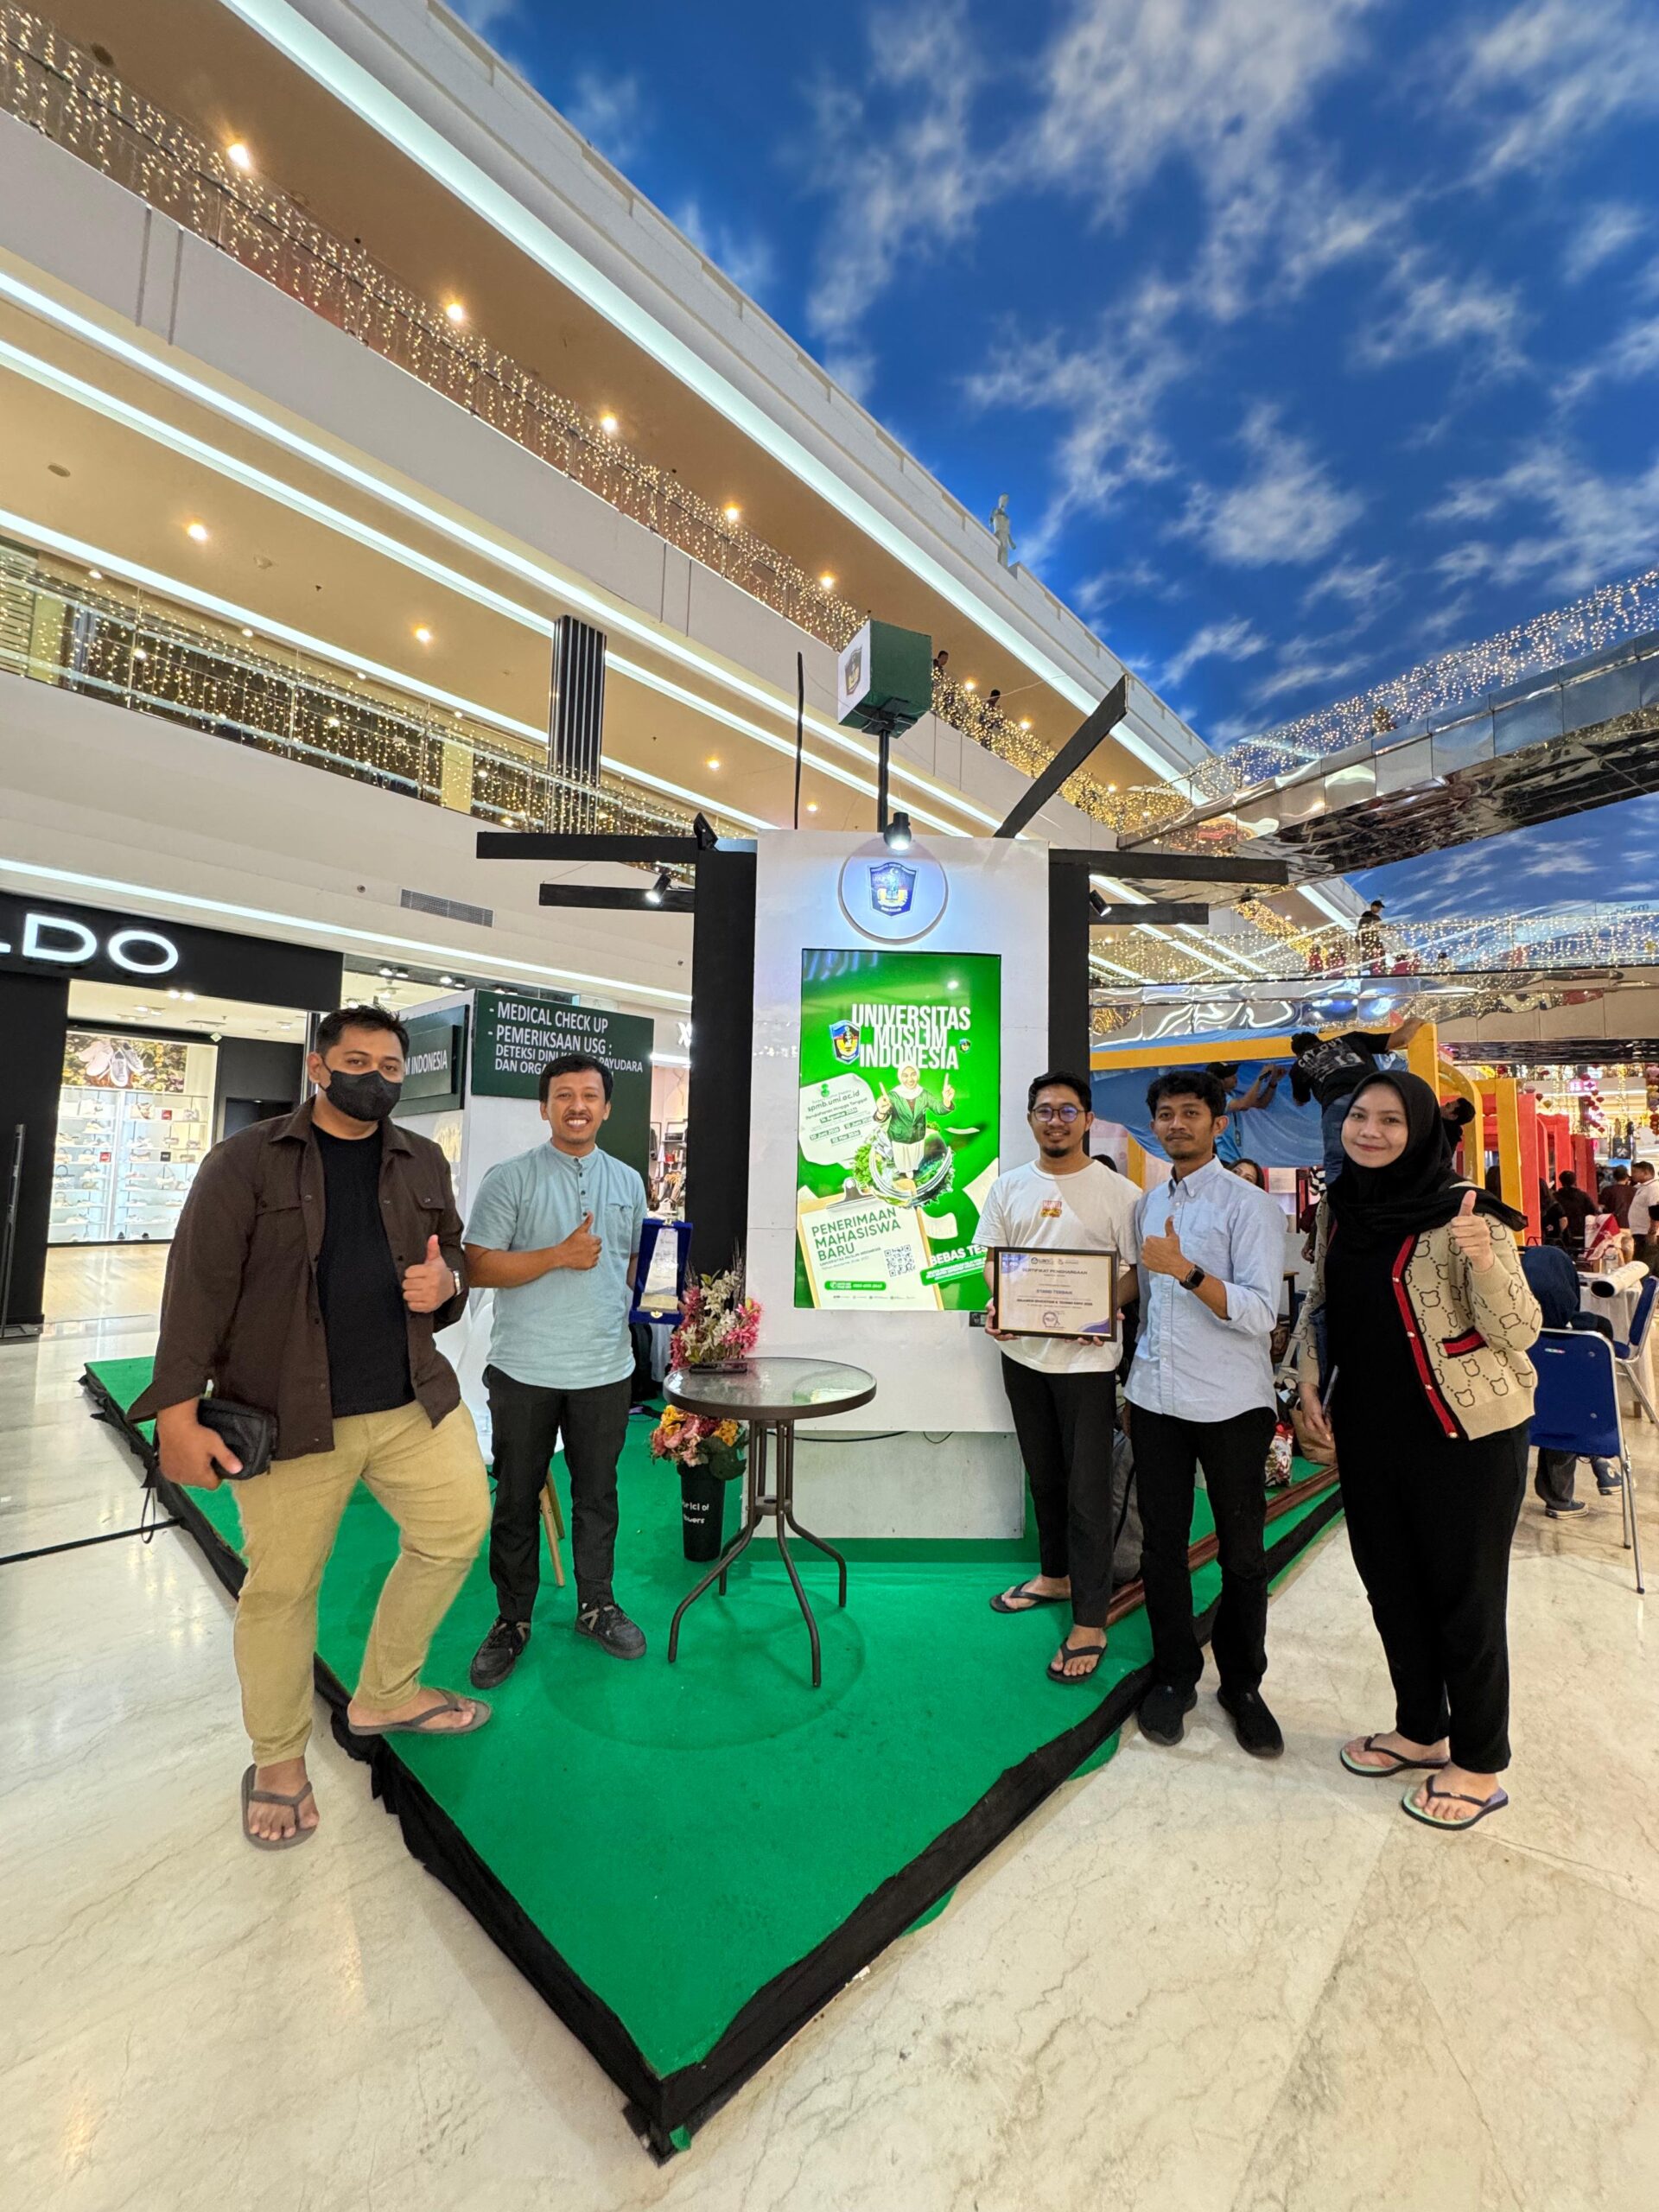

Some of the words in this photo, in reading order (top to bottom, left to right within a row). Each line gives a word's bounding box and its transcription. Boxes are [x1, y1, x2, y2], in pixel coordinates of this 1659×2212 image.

[497, 1001, 552, 1026] MEDICAL
[555, 1010, 591, 1032] CHECK
[593, 1016, 608, 1033] UP
[851, 1003, 971, 1031] UNIVERSITAS
[495, 1044, 536, 1060] DETEKSI
[537, 1049, 559, 1062] DINI
[496, 1024, 581, 1052] PEMERIKSAAN
[583, 1037, 606, 1055] USG
[410, 1049, 448, 1075] INDONESIA
[494, 1058, 518, 1072] DAN
[860, 1044, 959, 1071] INDONESIA
[811, 1206, 897, 1236] PENERIMAAN
[814, 1219, 901, 1249] MAHASISWA
[817, 1242, 855, 1262] BARU
[931, 1247, 967, 1266] BEBAS
